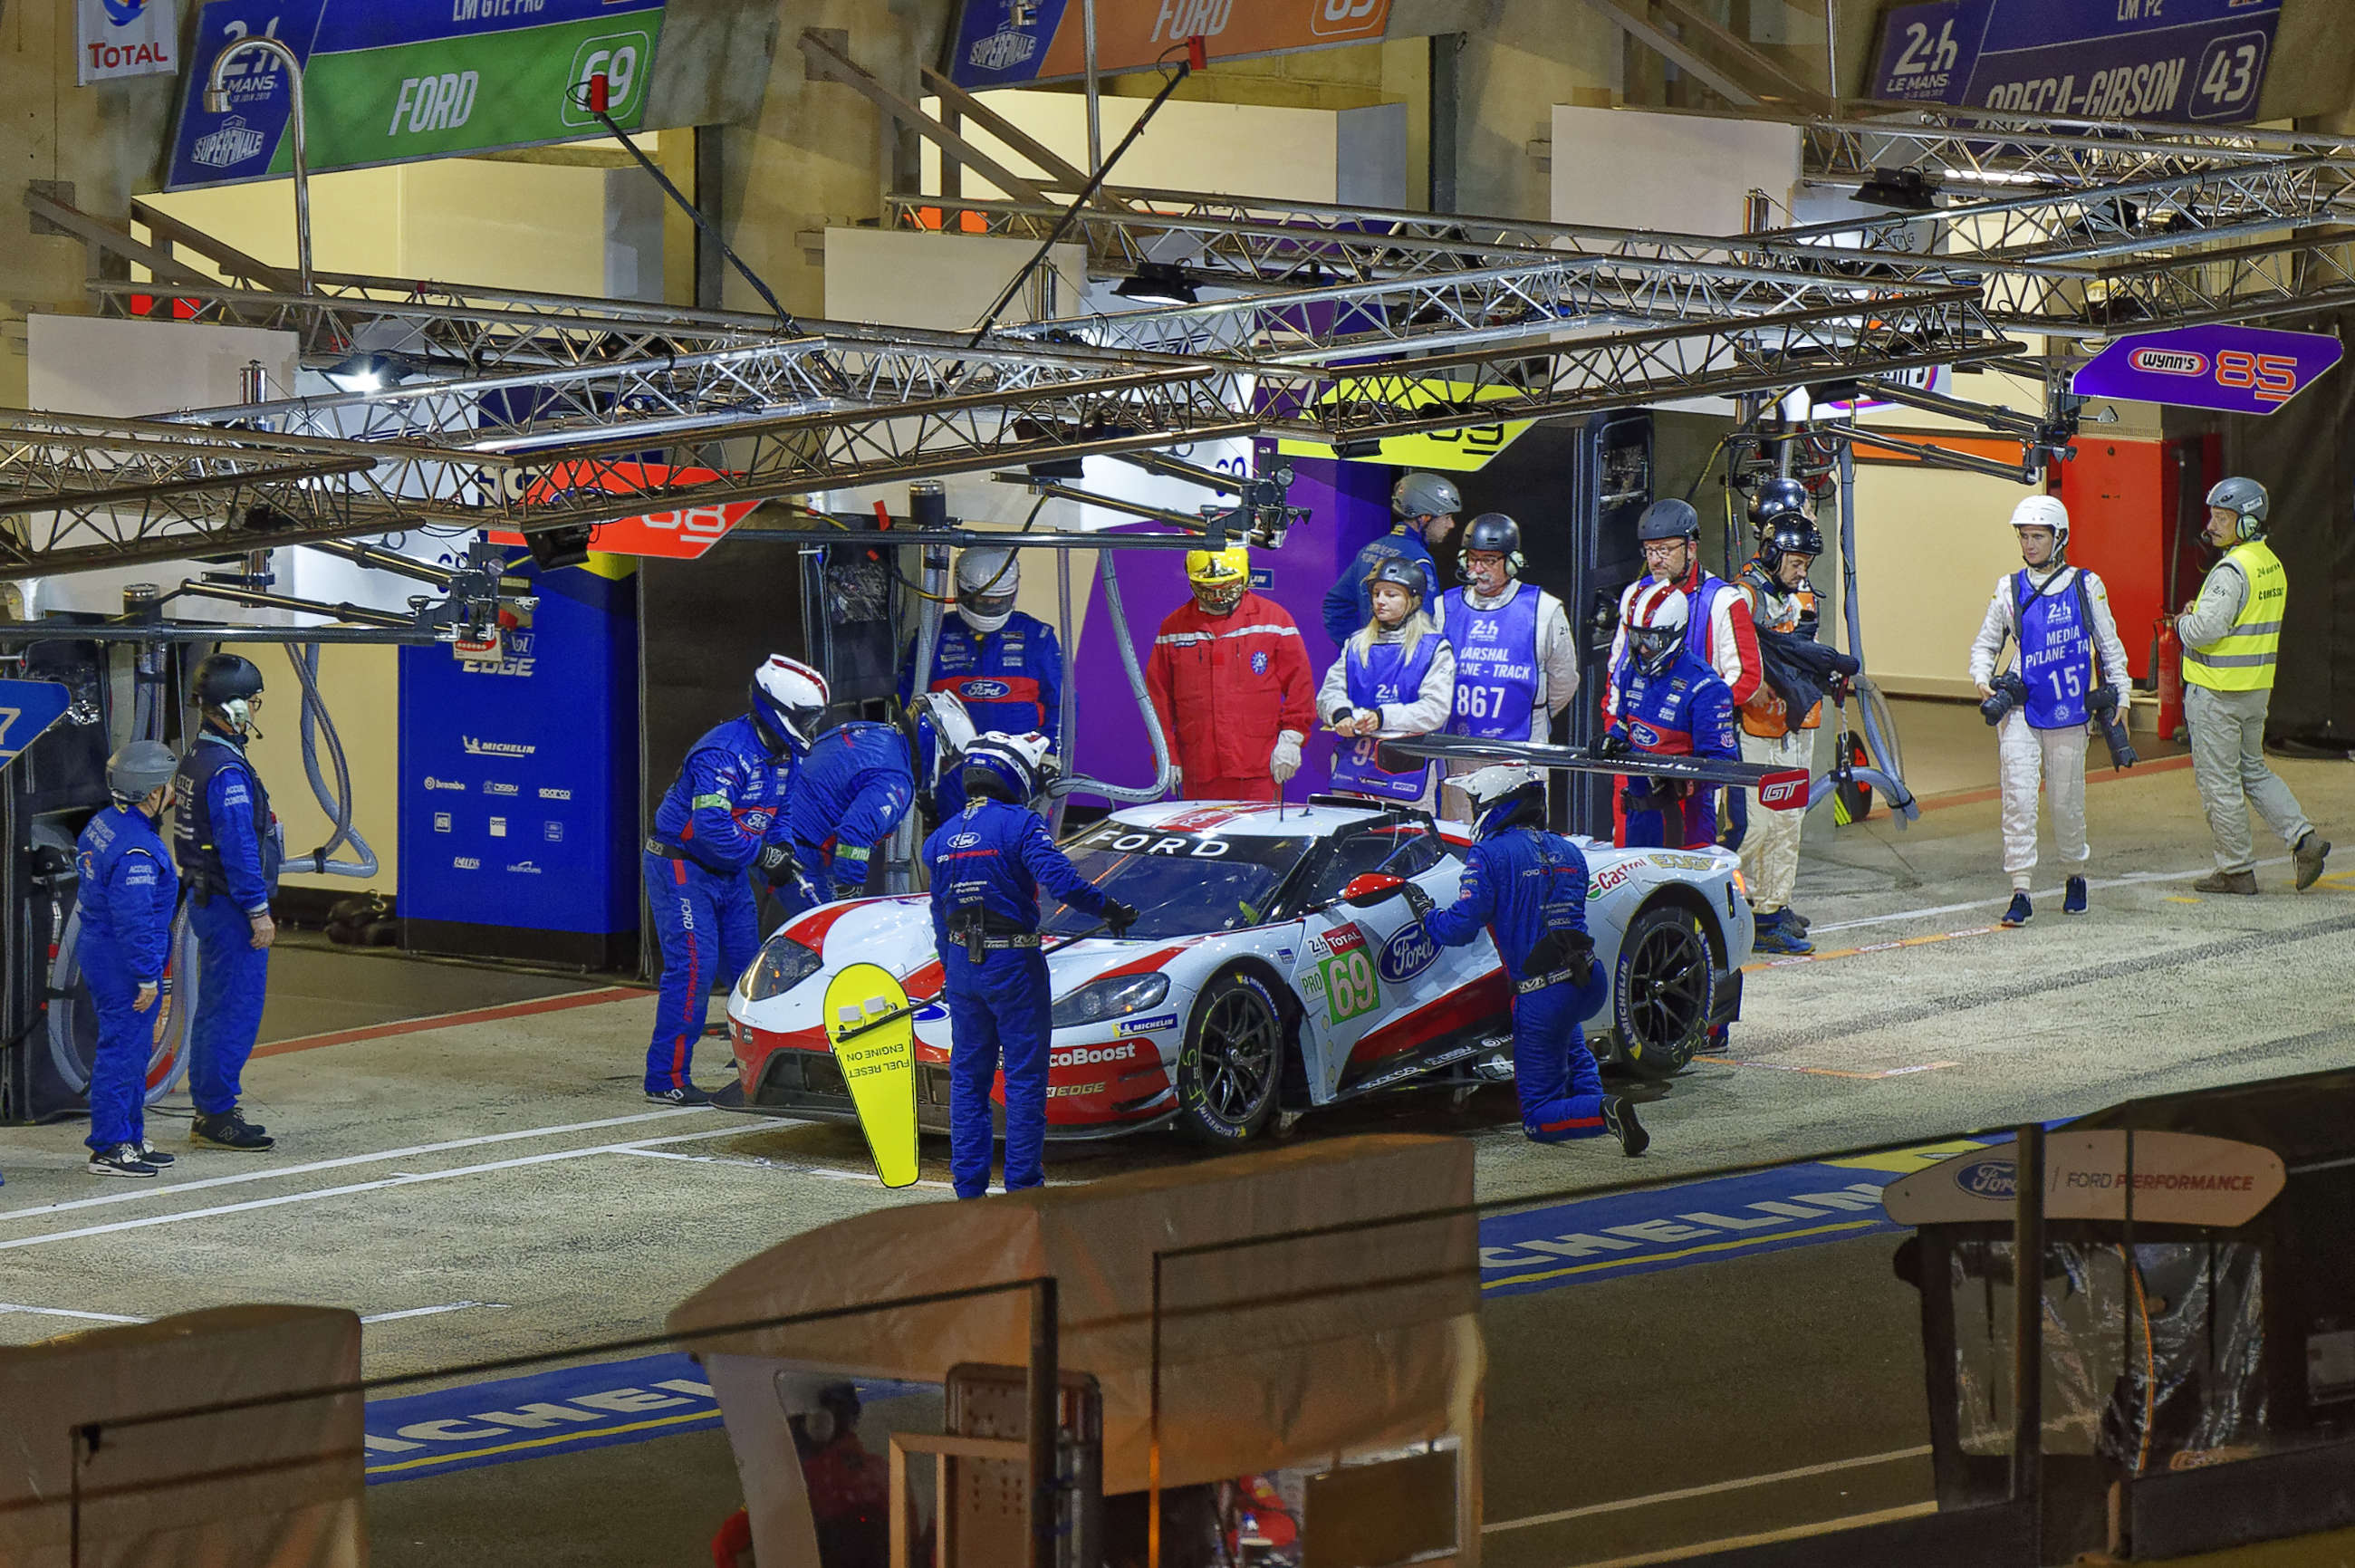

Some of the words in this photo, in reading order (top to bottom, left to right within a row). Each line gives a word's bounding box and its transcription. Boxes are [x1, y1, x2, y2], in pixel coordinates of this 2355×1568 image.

[88, 42, 168, 69] TOTAL
[970, 33, 1035, 68] SUPERFINALE
[227, 75, 275, 92] MANS
[2202, 44, 2256, 104] 43
[388, 70, 479, 136] FORD
[193, 128, 263, 165] SUPERFINALE
[2216, 350, 2298, 392] 85
[1471, 620, 1499, 635] 24h
[2046, 625, 2080, 646] MEDIA
[1493, 663, 1532, 680] TRACK
[2049, 663, 2085, 701] 15
[966, 682, 1001, 697] Ford
[1456, 684, 1506, 719] 867
[482, 741, 535, 755] MICHELIN
[436, 780, 466, 790] brembo
[1762, 779, 1807, 802] GT
[1085, 829, 1229, 857] FORD
[680, 898, 695, 930] FORD
[1308, 937, 1329, 953] 24h
[1327, 931, 1361, 948] TOTAL
[1391, 929, 1435, 976] Ford
[1302, 972, 1322, 996] PRO
[1329, 951, 1373, 1017] 69
[1618, 960, 1631, 1035] MICHELIN
[1133, 1019, 1174, 1032] MICHELIN
[847, 1051, 863, 1062] ON
[865, 1043, 904, 1058] ENGINE
[1049, 1042, 1136, 1068] coBoost
[848, 1064, 881, 1079] RESET
[884, 1058, 910, 1071] FUEL
[1056, 1082, 1106, 1097] EDGE
[2066, 1173, 2112, 1188] FORD
[2114, 1175, 2254, 1191] PERFORMANCE
[1480, 1183, 1884, 1268] CHELIN
